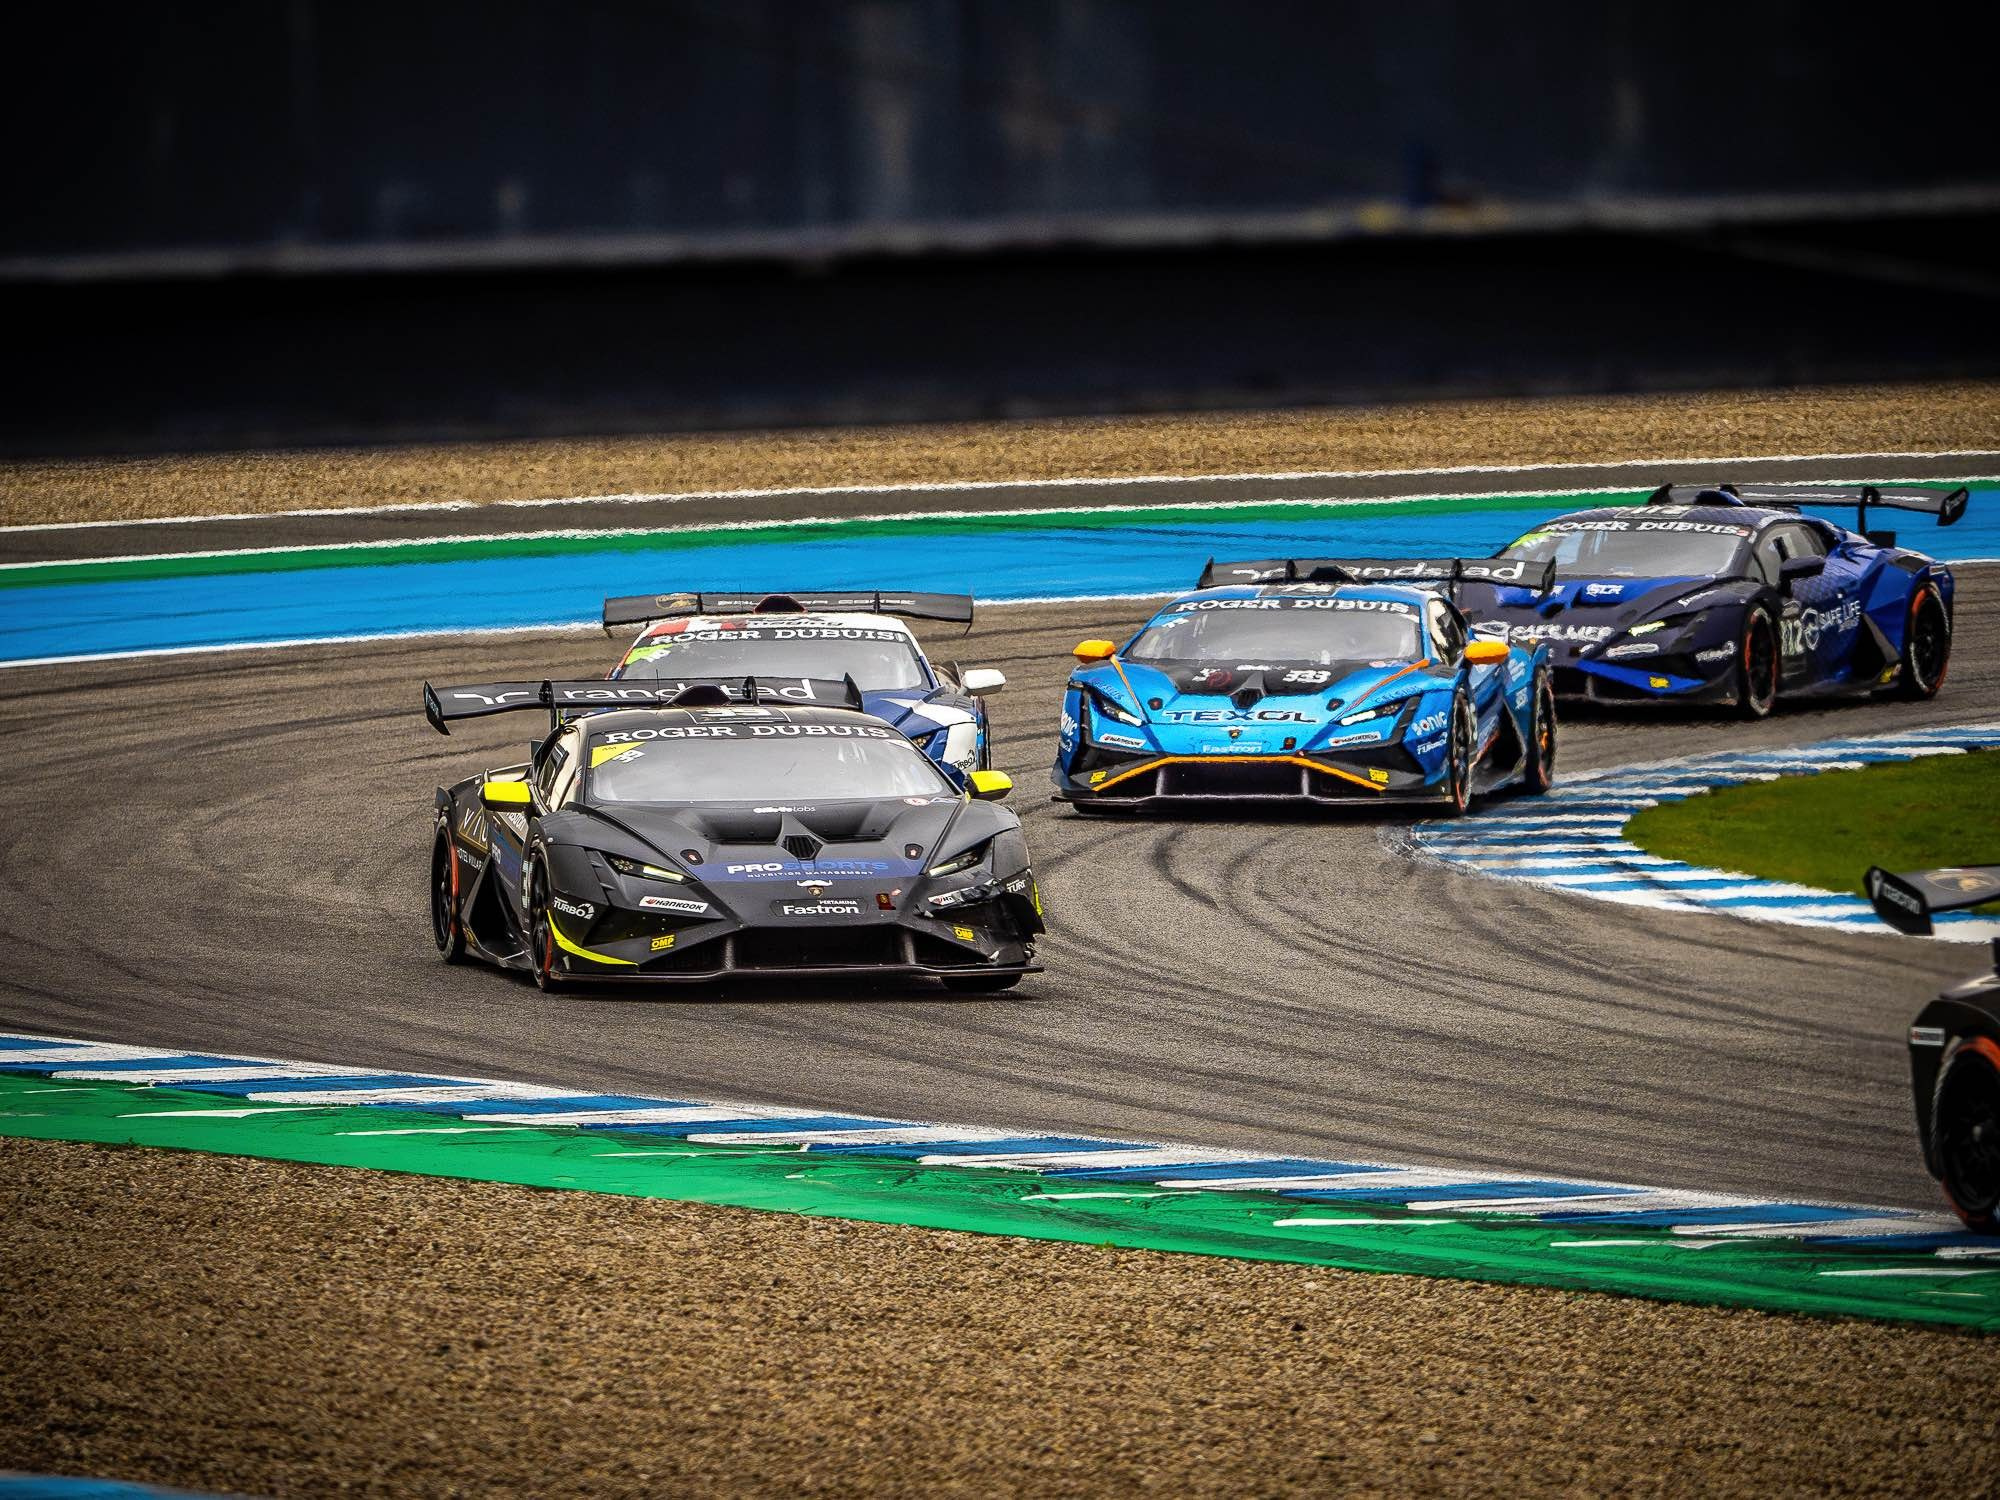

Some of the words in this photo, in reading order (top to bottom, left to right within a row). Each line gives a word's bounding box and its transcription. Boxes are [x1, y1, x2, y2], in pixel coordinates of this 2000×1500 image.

[1635, 521, 1738, 535] DUBUIS
[1175, 599, 1282, 613] ROGER
[1291, 600, 1410, 614] DUBUIS
[650, 629, 762, 646] ROGER
[774, 629, 896, 641] DUBUIS
[562, 679, 817, 700] randtad
[1163, 708, 1320, 725] TEXOL
[604, 727, 738, 744] ROGER
[749, 725, 891, 739] DUBUIS
[613, 749, 647, 764] 39
[783, 905, 860, 915] Fastron
[651, 936, 675, 949] OMP
